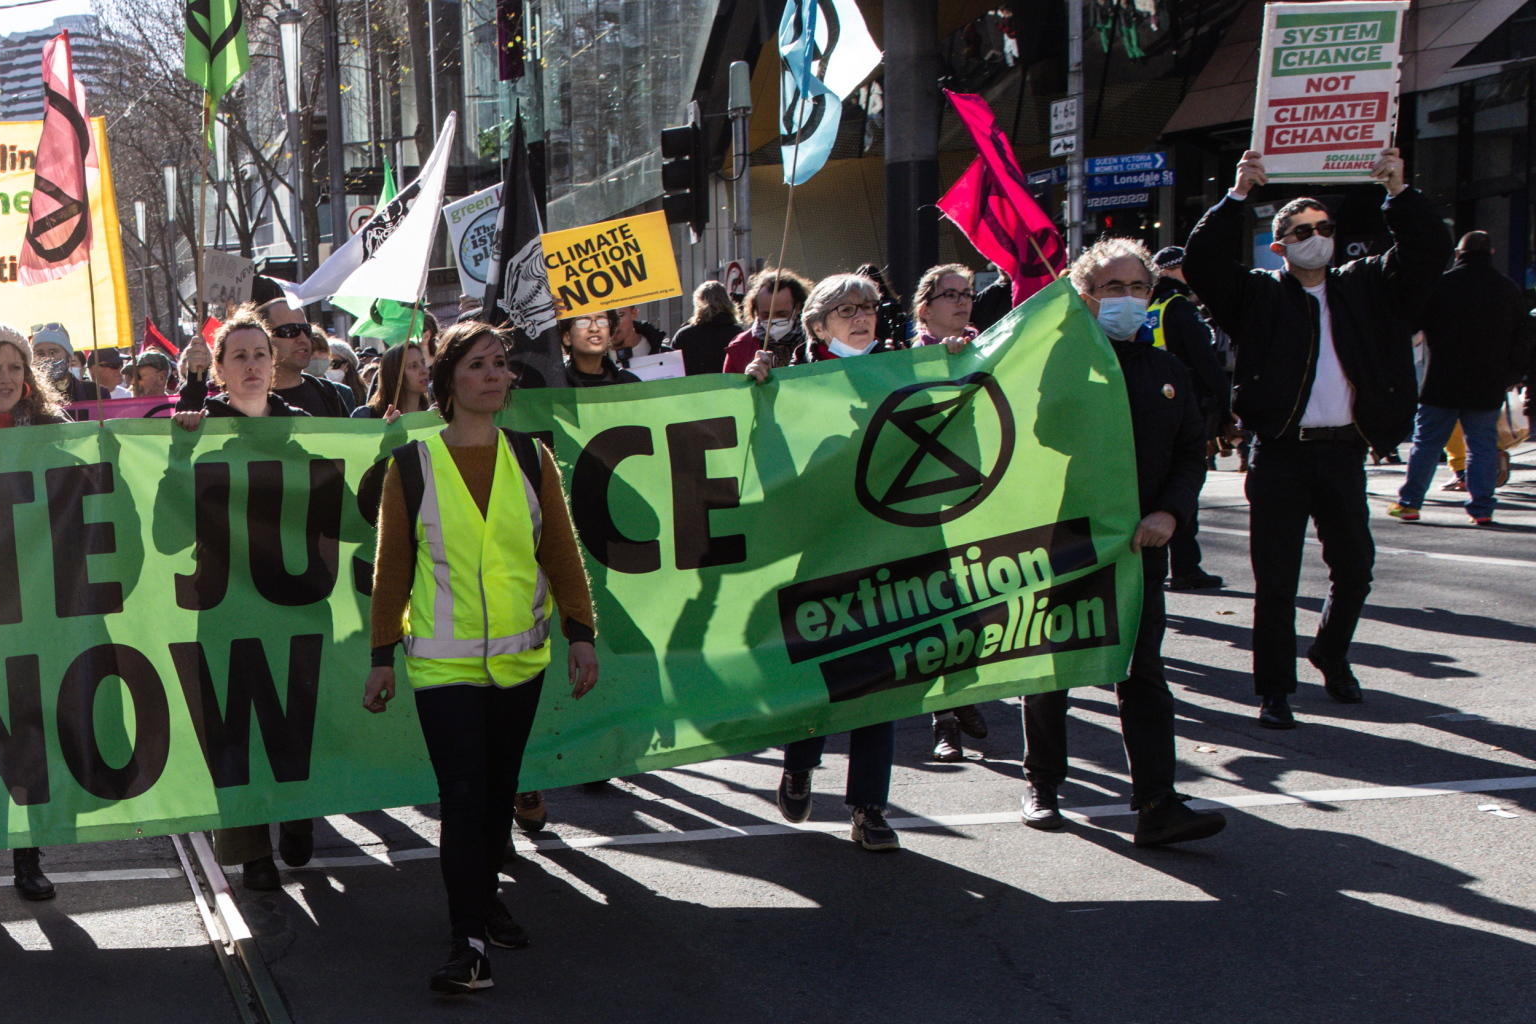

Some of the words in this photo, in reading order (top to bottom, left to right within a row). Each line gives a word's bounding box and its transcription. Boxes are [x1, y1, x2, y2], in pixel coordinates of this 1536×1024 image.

[1281, 23, 1379, 45] SYSTEM
[1282, 45, 1383, 67] CHANGE
[1305, 75, 1356, 93] NOT
[1273, 101, 1377, 123] CLIMATE
[1275, 124, 1376, 146] CHANGE
[1322, 161, 1376, 170] ALLIANCE
[1325, 153, 1376, 162] SOCIALIST
[1113, 172, 1160, 185] Lonsdale
[450, 195, 494, 224] green
[544, 223, 634, 269] CLIMATE
[565, 238, 641, 281] ACTION
[557, 253, 648, 312] NOW
[174, 416, 747, 611] JUCE
[795, 546, 1052, 643] extinction
[888, 588, 1107, 681] rebellion
